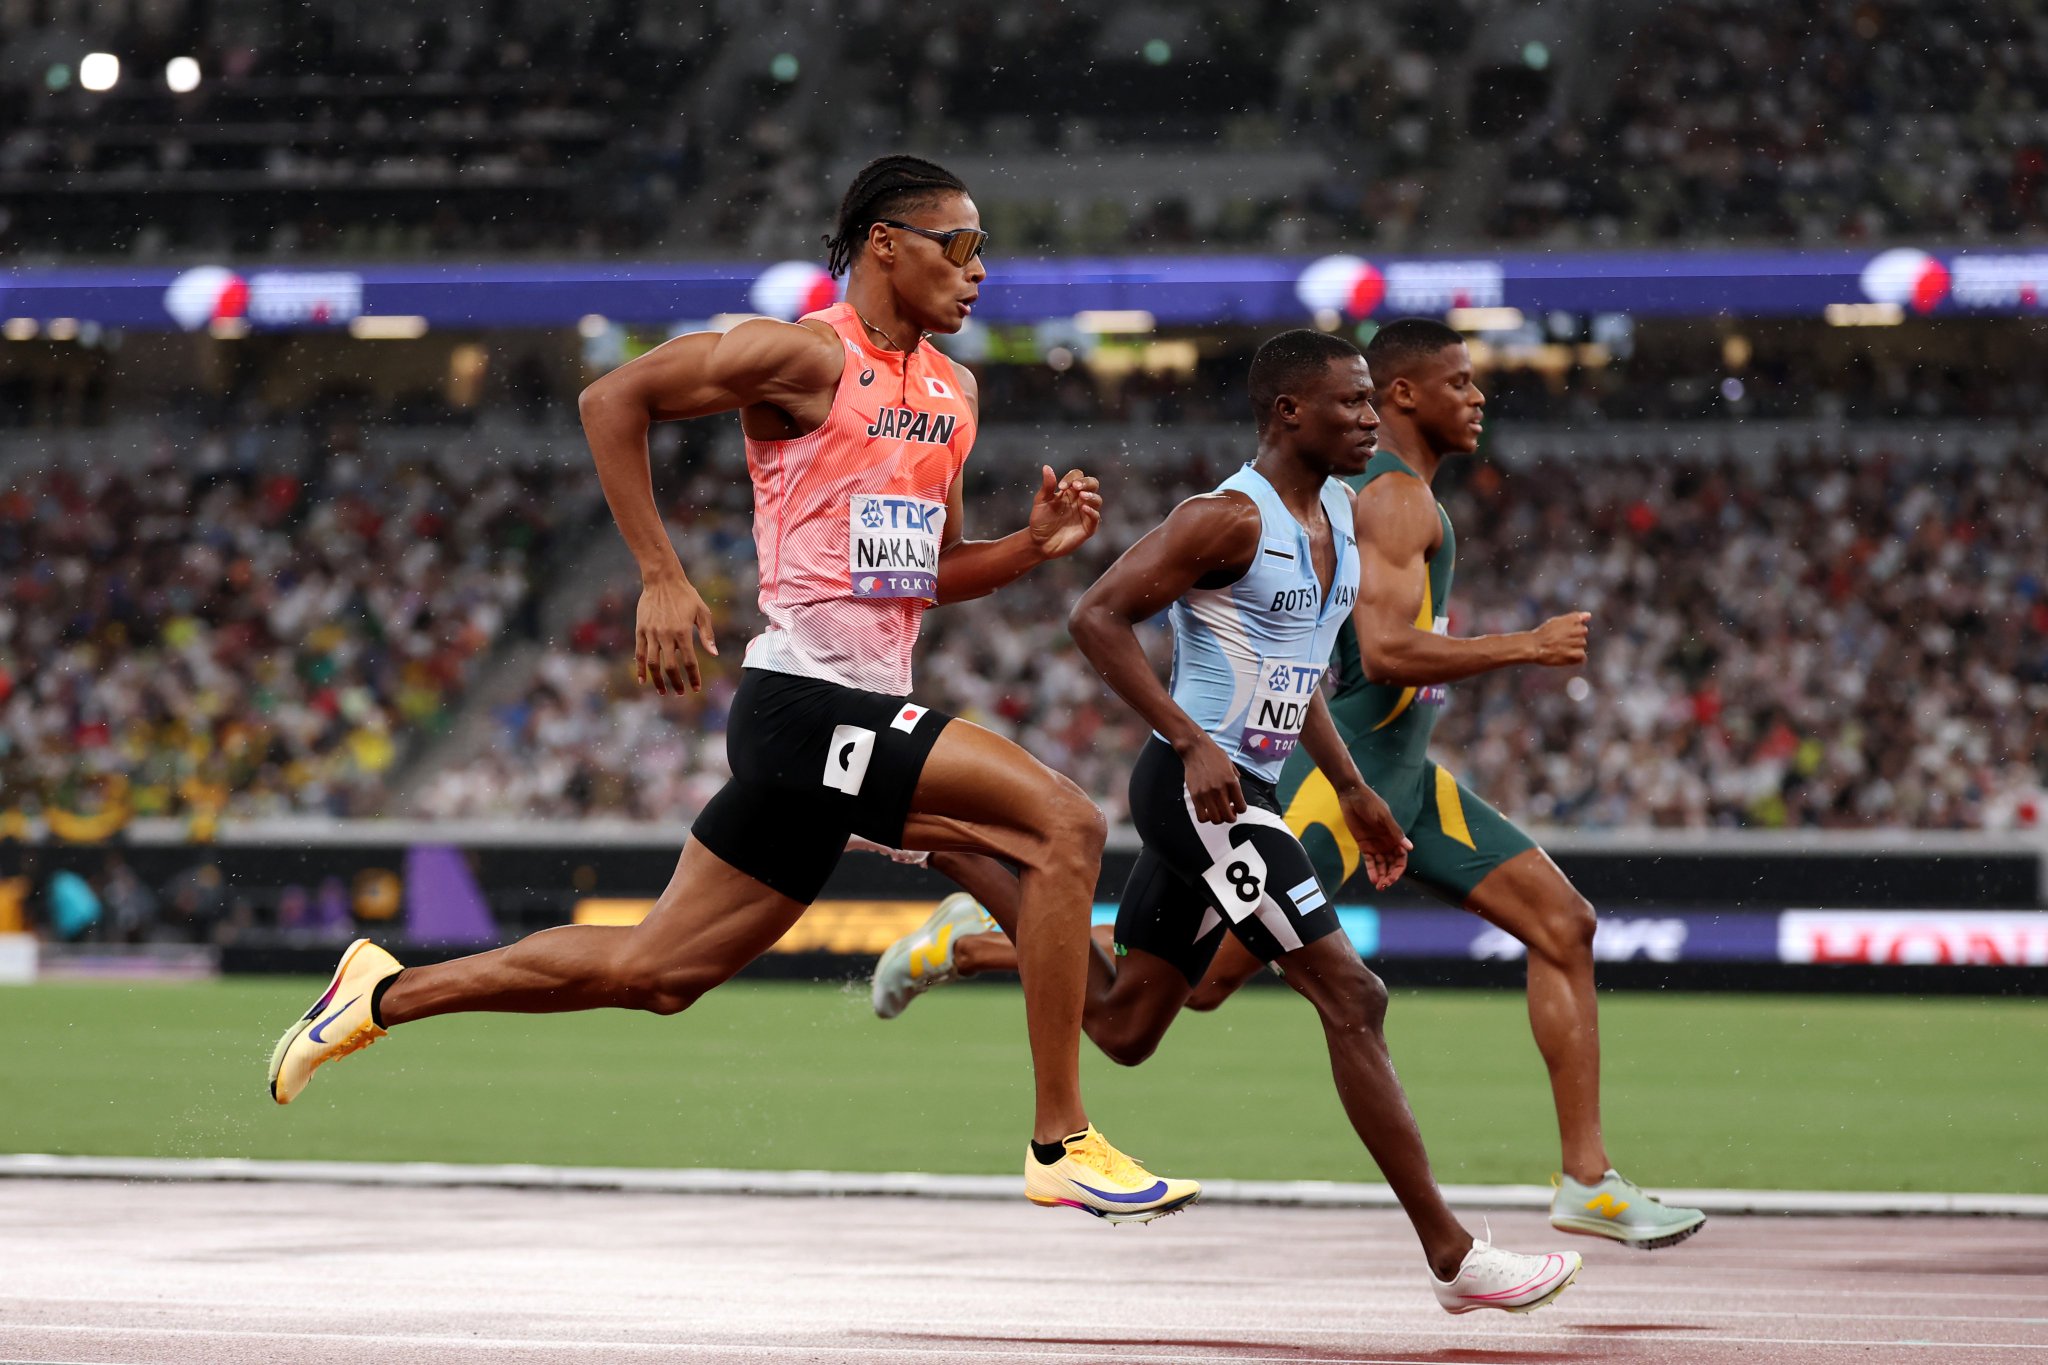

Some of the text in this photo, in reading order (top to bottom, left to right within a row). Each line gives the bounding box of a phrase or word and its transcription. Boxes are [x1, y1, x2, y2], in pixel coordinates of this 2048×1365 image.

[867, 407, 956, 445] JAPAN
[883, 500, 940, 534] TDK
[1292, 667, 1325, 694] TD
[1226, 861, 1260, 902] 8
